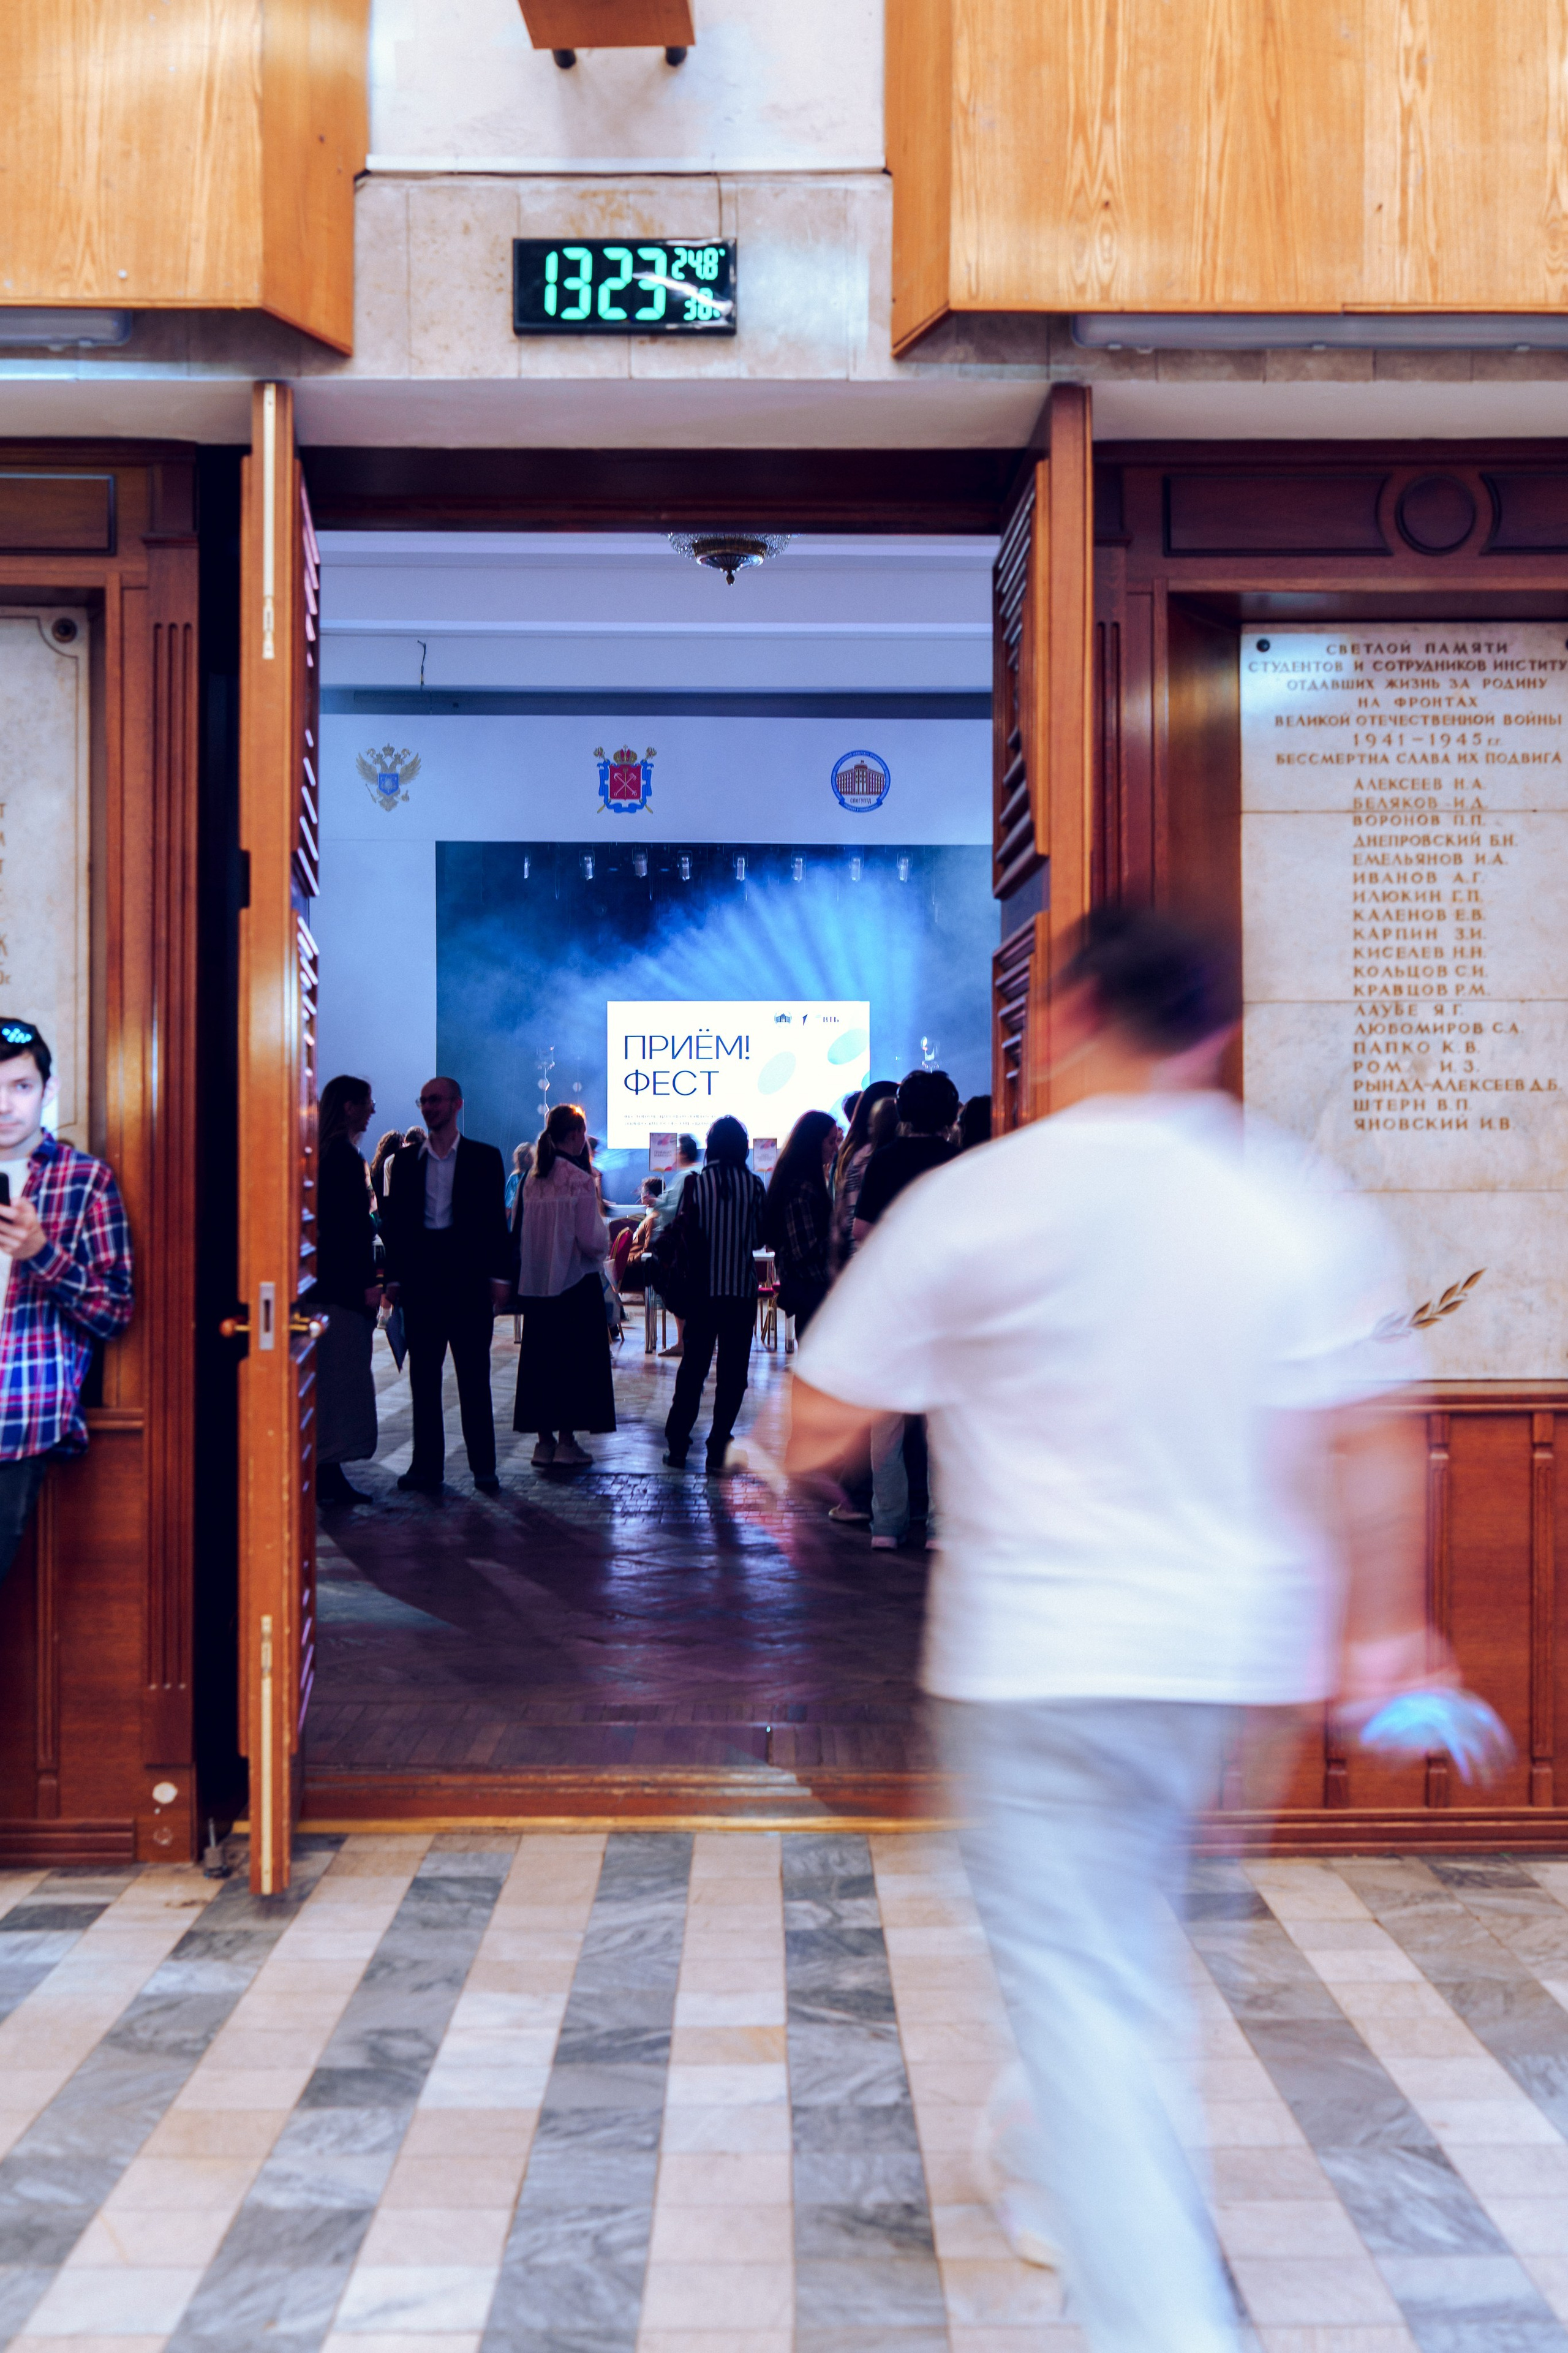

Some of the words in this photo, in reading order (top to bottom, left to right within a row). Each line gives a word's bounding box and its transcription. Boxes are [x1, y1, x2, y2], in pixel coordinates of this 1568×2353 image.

[544, 247, 667, 320] 1323
[1327, 640, 1411, 655] СВЕТЛОЙ
[1425, 643, 1509, 655] ПАМЯТИ
[1248, 660, 1343, 673] СТУДЕНТОВ
[1354, 660, 1364, 671] И
[1373, 659, 1487, 671] СОТРУДНИКОВ
[1287, 679, 1374, 691] ОТДАВШИХ
[1385, 678, 1440, 690] ЖИЗНЬ
[1449, 678, 1470, 689] ЗА
[1482, 677, 1548, 690] РОДИНУ
[1358, 697, 1380, 708] НА
[1394, 697, 1479, 708] ФРОНТАХ
[1275, 712, 1351, 727] ВЕЛИКОЙ
[1356, 711, 1495, 727] ОТЕЧЕСТВЕННОЙ
[1503, 711, 1562, 726] ВОЙНЫ
[1276, 753, 1390, 765] БЕССМЕРТНА
[1396, 753, 1451, 765] СЛАВА
[1457, 753, 1479, 764] ИХ
[1485, 752, 1562, 765] ПОДВИГА
[1354, 777, 1443, 791] АЛЕКСЕЕВ
[1353, 797, 1438, 810] БЕЛЯКОВ
[1353, 815, 1441, 826] ВОРОНОВ
[1354, 831, 1482, 848] ДНЕПРОВСКИЙ
[1353, 853, 1464, 866] ЕМЕЛЬЯНОВ
[1353, 871, 1438, 884] ИВАНОВ
[1353, 890, 1442, 904] ИЛЮКИН
[1353, 908, 1447, 922] КАЛЕНОВ
[1353, 927, 1438, 941] КАРПИН
[1353, 946, 1445, 959] КИСЕЛЕВ
[1353, 965, 1448, 978] КОЛЬЦОВ
[1353, 984, 1448, 997] КРАВЦОВ
[1355, 1003, 1419, 1018] ЛАУБЕ
[1355, 1022, 1483, 1035] ЛЮБОМИРОВ
[624, 1029, 750, 1060] ПРИЁМ!
[1353, 1041, 1431, 1054] ПАПКО
[1353, 1060, 1403, 1073] РОМ
[624, 1069, 720, 1096] ФЕСТ
[1353, 1079, 1525, 1092] РЫНДА-АЛЕКСЕЕВ
[1353, 1099, 1426, 1112] ШТЕРН
[1354, 1115, 1469, 1131] ЯНОВСКИЙ
